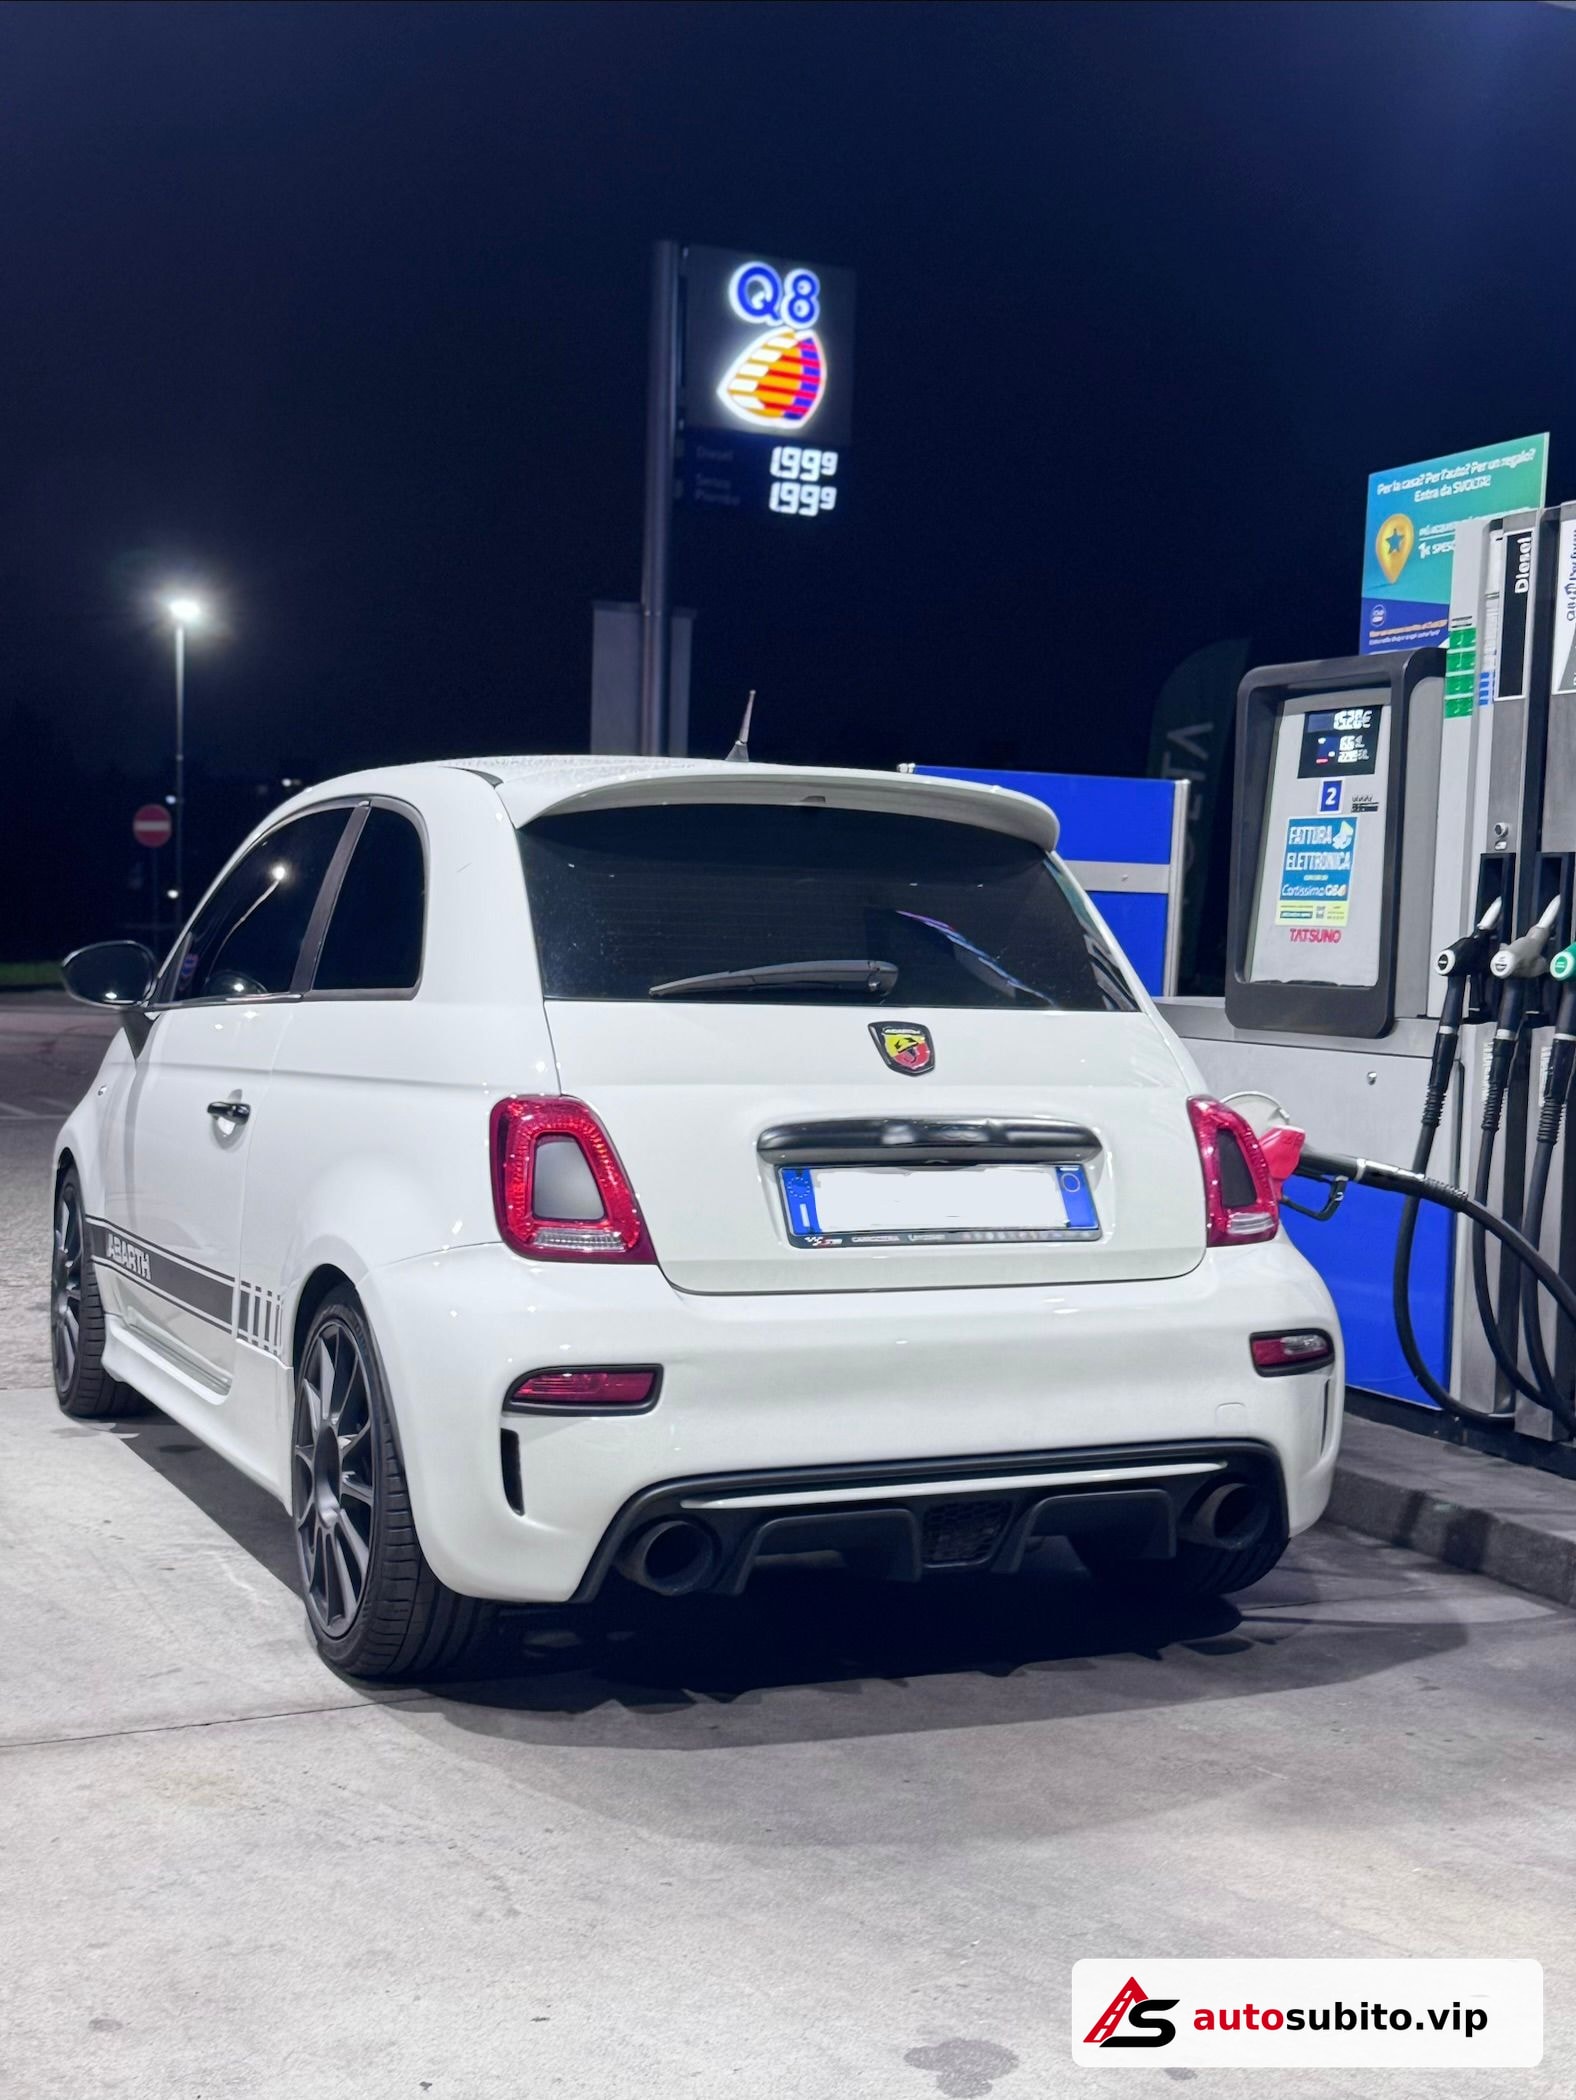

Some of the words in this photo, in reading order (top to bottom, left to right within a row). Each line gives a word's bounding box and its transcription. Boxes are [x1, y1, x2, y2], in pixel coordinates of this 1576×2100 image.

[729, 262, 820, 329] Q8
[770, 446, 838, 482] 1999
[769, 482, 837, 516] 1999
[1515, 537, 1532, 593] Diesel
[1325, 787, 1337, 805] 2
[1289, 826, 1333, 844] FATTURA
[1286, 851, 1351, 871] ELETTRONICA
[1290, 928, 1342, 944] TATSUNO
[107, 1233, 151, 1280] ABARTH
